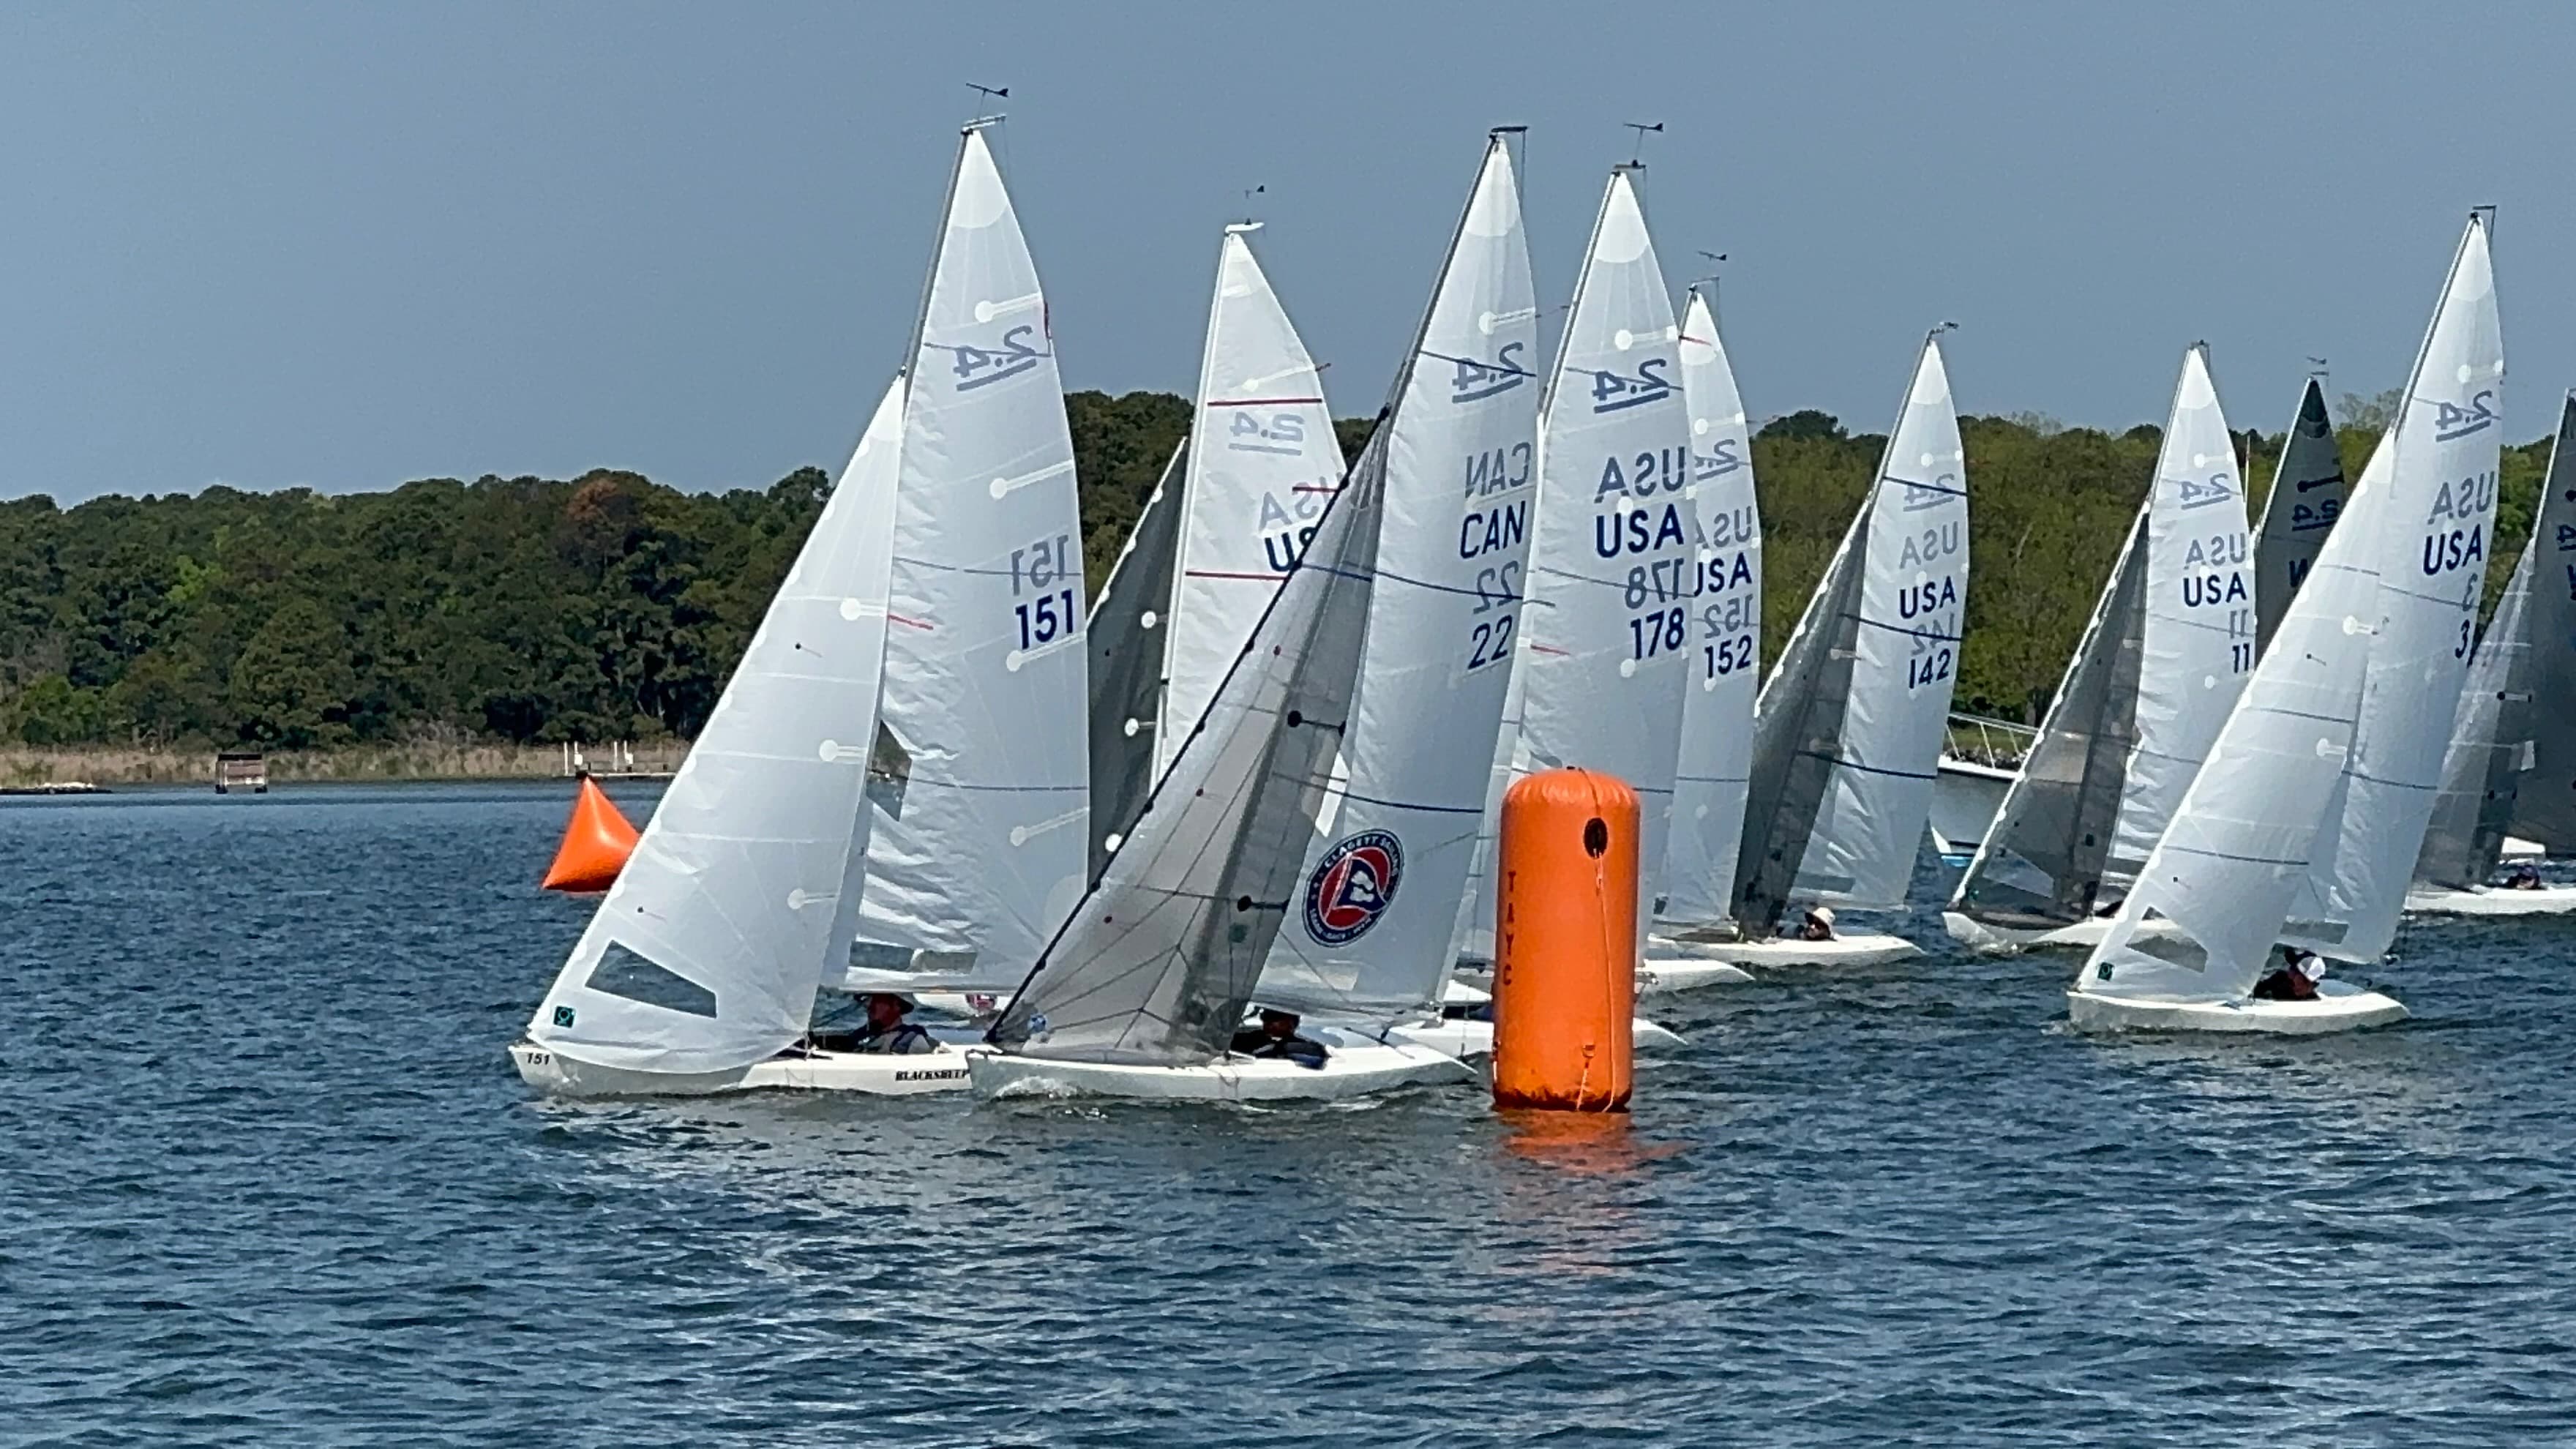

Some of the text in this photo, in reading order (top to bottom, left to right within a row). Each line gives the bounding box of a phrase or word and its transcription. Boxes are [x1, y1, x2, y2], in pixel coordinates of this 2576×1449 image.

[1460, 501, 1526, 559] CAN
[1596, 503, 1684, 558] USA
[2423, 523, 2482, 575] USA
[1900, 575, 1955, 618] USA
[2183, 572, 2247, 607] USA
[1015, 589, 1074, 649] 151
[1630, 607, 1684, 659] 178
[1467, 615, 1513, 670] 22
[1704, 634, 1753, 678] 152
[2232, 643, 2250, 673] 11
[1909, 648, 1951, 689] 142
[1325, 836, 1379, 868] CLAGETT
[527, 1052, 551, 1066] 151
